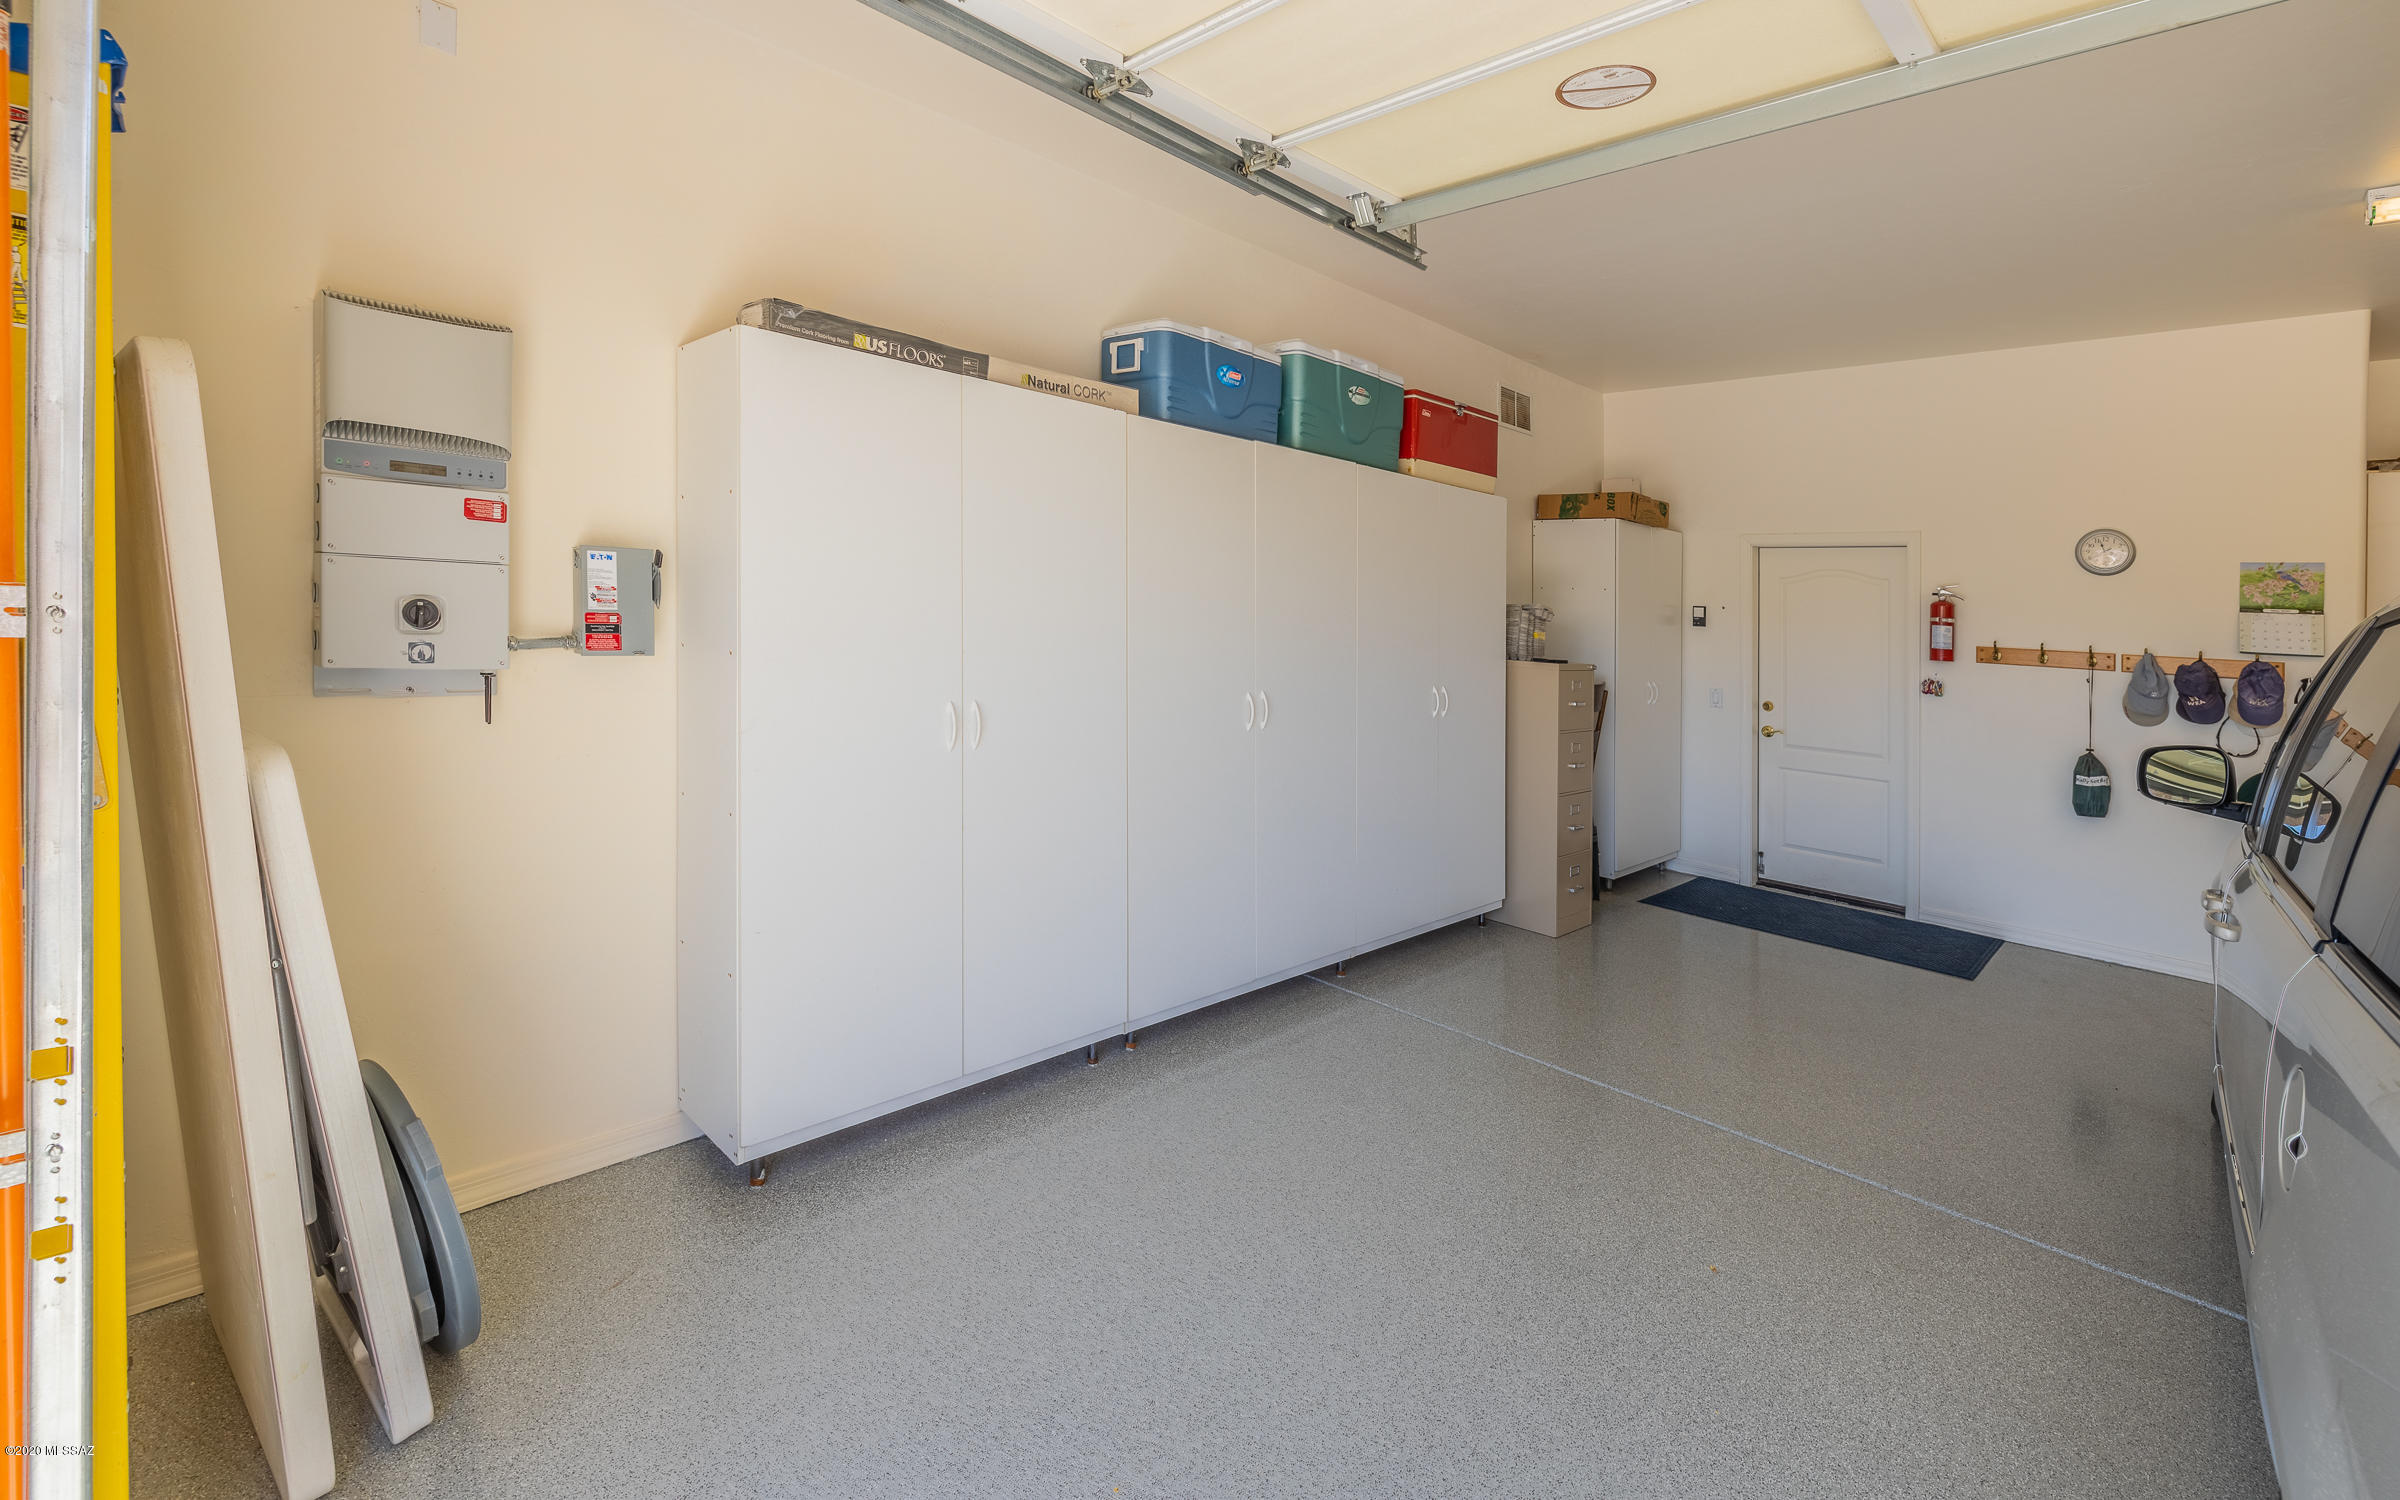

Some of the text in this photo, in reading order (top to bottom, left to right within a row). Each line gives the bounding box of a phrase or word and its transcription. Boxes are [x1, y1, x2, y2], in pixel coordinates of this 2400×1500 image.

[801, 327, 814, 336] Cork
[814, 331, 836, 342] Flooring
[836, 336, 850, 345] from
[1027, 374, 1070, 395] Natural
[1607, 492, 1616, 511] BOX
